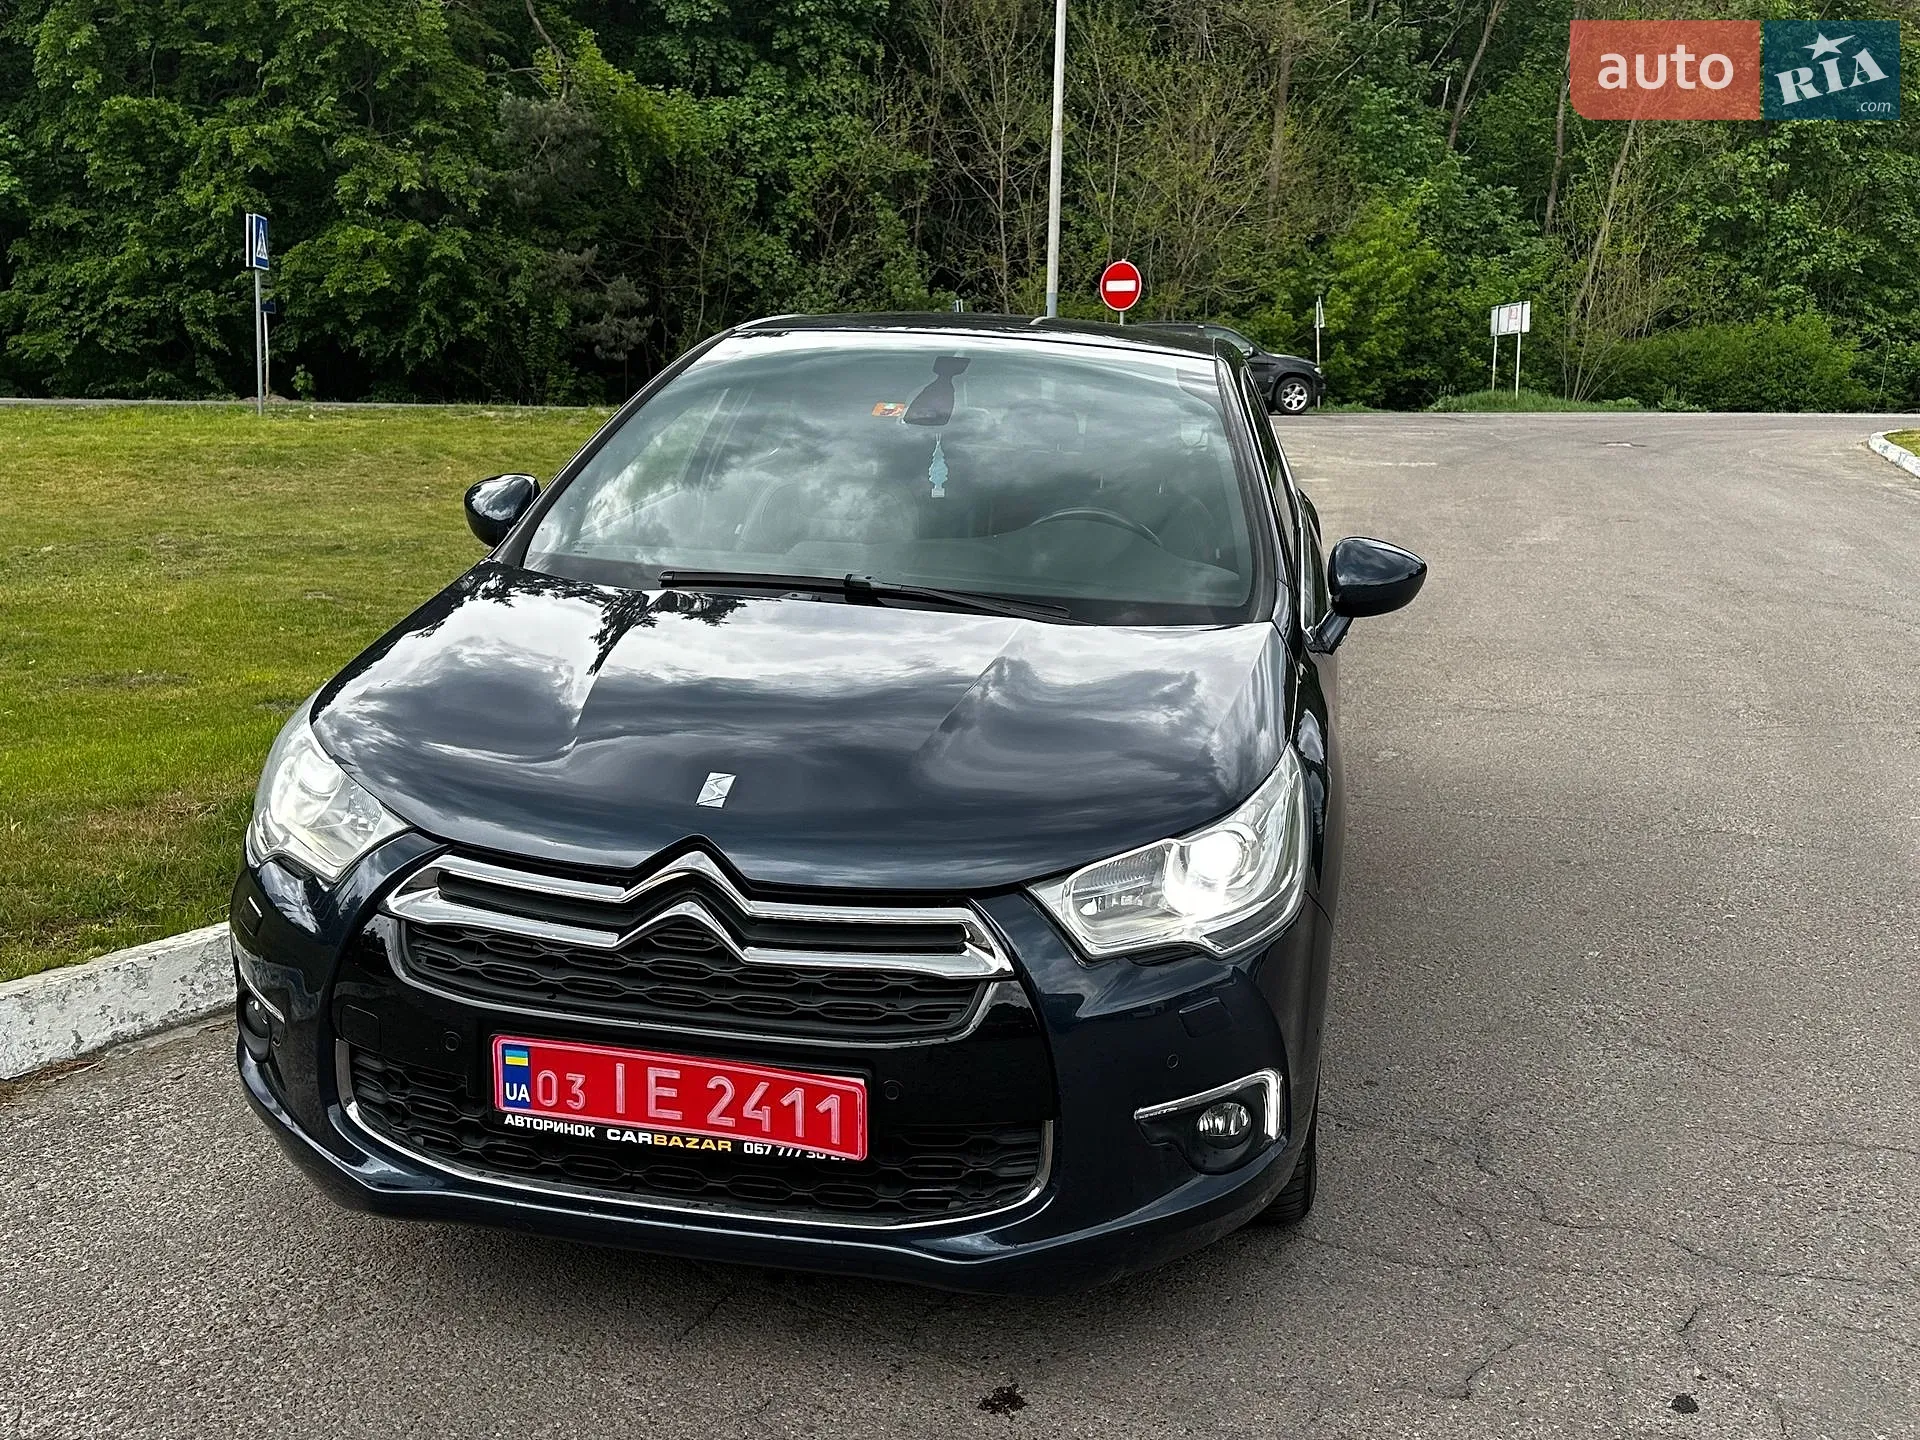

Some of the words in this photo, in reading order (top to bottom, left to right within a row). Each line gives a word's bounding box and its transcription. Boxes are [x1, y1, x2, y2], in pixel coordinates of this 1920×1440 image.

[505, 1082, 530, 1103] UA
[536, 1069, 586, 1110] 03
[615, 1063, 683, 1121] IE
[706, 1075, 841, 1145] 2411
[504, 1113, 596, 1138] АВТОРИНОК
[606, 1128, 732, 1152] CARBAZAR
[743, 1142, 772, 1155] 067
